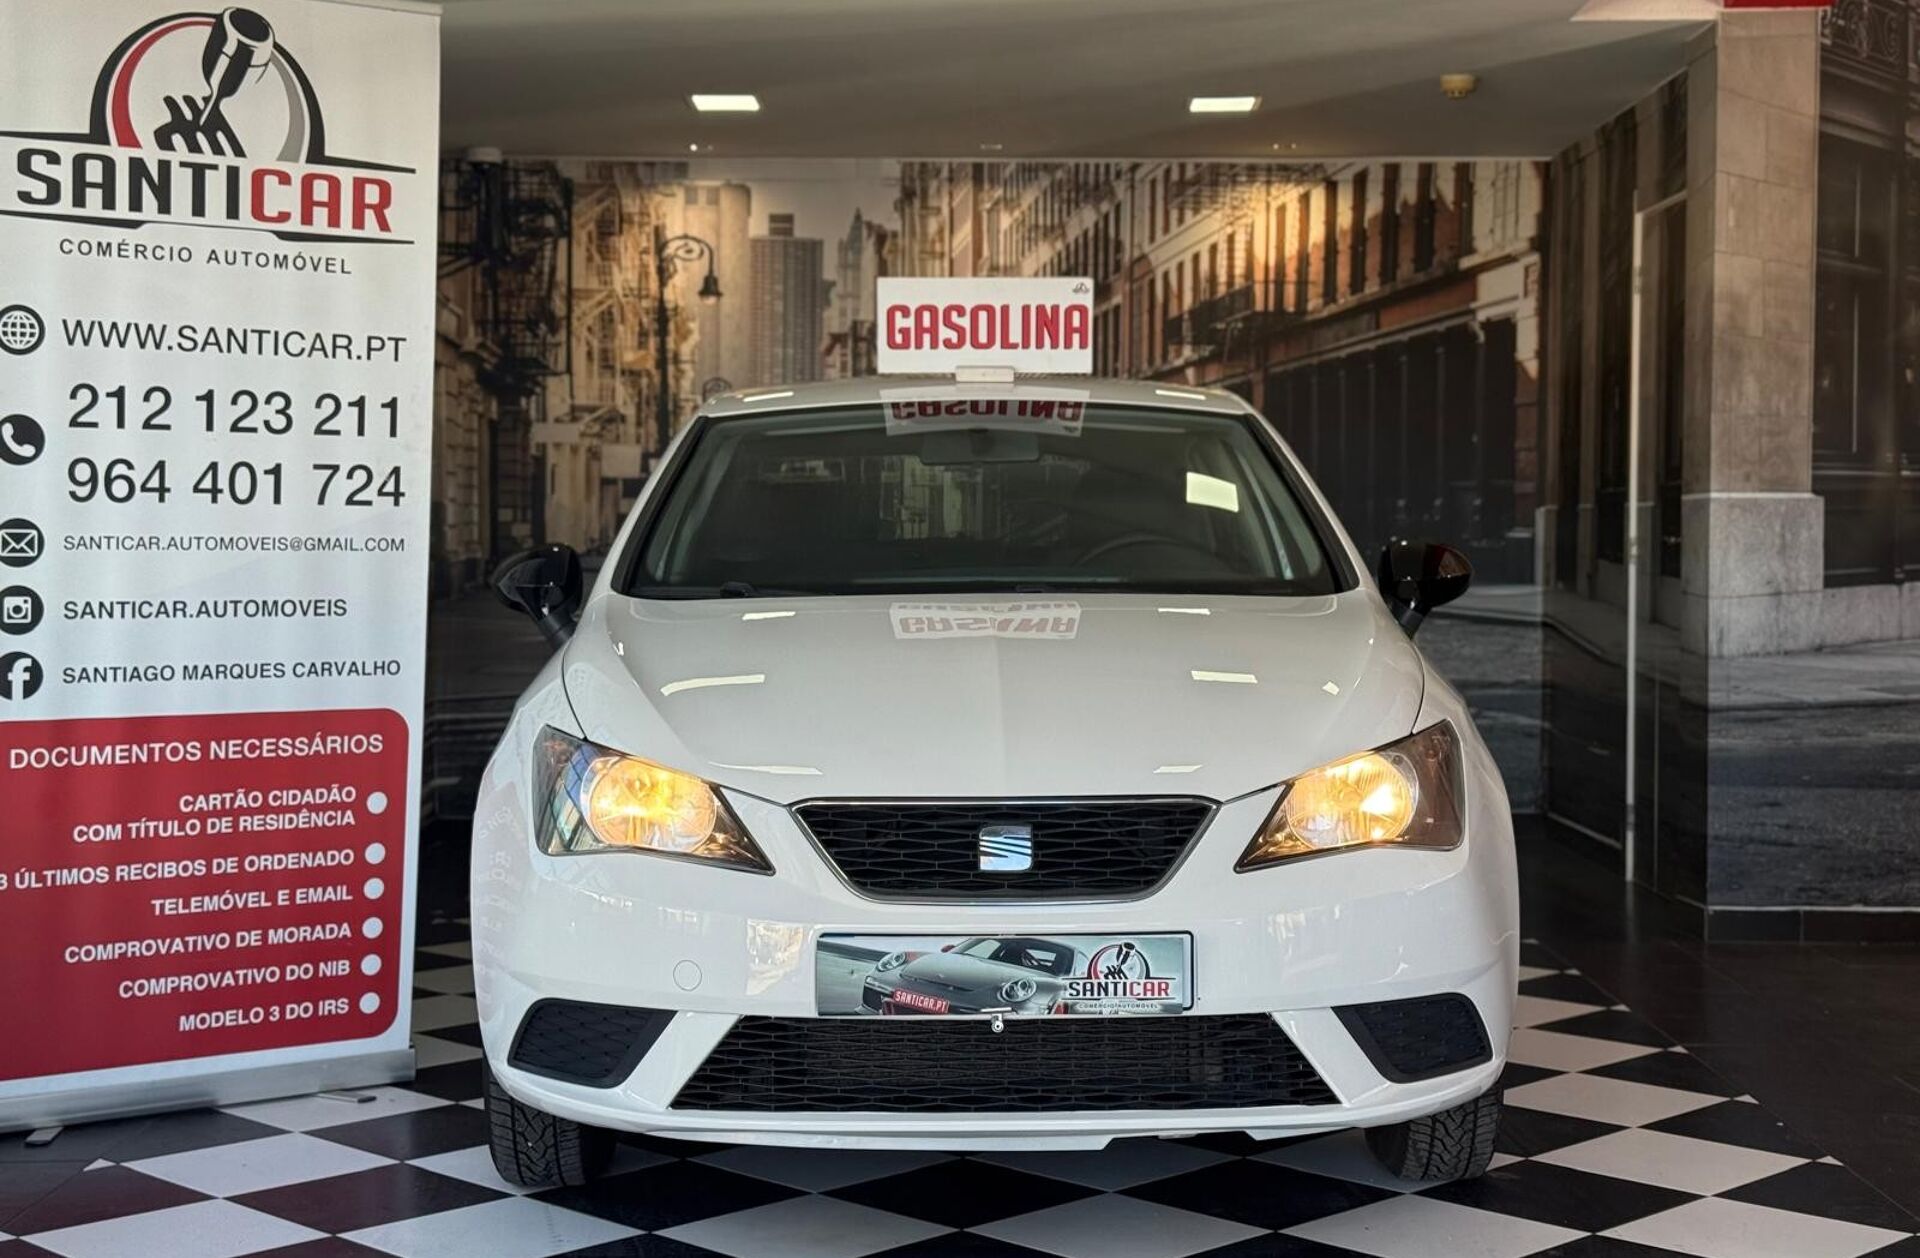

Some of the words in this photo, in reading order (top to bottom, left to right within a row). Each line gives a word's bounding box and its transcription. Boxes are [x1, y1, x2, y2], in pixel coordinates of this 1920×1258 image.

[17, 147, 393, 233] SANTICAR
[60, 238, 192, 263] COMÉRCIO
[207, 248, 352, 275] AUTOMÓVEL
[62, 318, 407, 362] WWW.SANTICAR.PT
[886, 304, 1089, 350] GASOLINA
[68, 383, 172, 431] 212
[195, 389, 293, 435] 123
[314, 393, 398, 438] 211
[68, 457, 171, 503] 964
[193, 461, 282, 505] 401
[312, 464, 405, 507] 724
[63, 536, 405, 553] SANTICAR.AUTOMOVEIS@GMAIL.COM
[63, 599, 347, 620] SANTICAR.AUTOMOVEIS
[62, 666, 175, 684] SANTIAGO
[182, 662, 286, 681] MARQUES
[293, 660, 401, 678] CARVALHO
[10, 741, 201, 769] DOCUMENTOS
[210, 732, 383, 760] NECESSÁRIOS
[179, 790, 263, 813] CARTÃO
[269, 784, 356, 806] CIDADÃO
[73, 825, 122, 842] COM
[128, 817, 200, 839] TÍTULO
[207, 817, 233, 834] DE
[239, 808, 355, 832] RESIDÊNCIA
[14, 866, 110, 889] ÚLTIMOS
[116, 860, 206, 882] RECIBOS
[212, 858, 238, 874] DE
[244, 849, 354, 872] ORDENADO
[152, 889, 271, 916] TELEMÓVEL
[278, 890, 290, 906] E
[296, 885, 353, 905] EMAIL
[65, 933, 230, 963] COMPROVATIVO
[236, 930, 263, 947] DE
[268, 923, 352, 945] MORADA
[119, 967, 280, 998] COMPROVATIVO
[285, 963, 313, 980] DO
[319, 960, 350, 976] NIB
[1068, 981, 1170, 997] SANTICAR
[179, 1007, 264, 1031] MODELO
[269, 1005, 280, 1021] 3
[285, 1001, 313, 1019] DO
[319, 999, 349, 1015] IRS
[894, 990, 947, 1013] SANTICAR.PT
